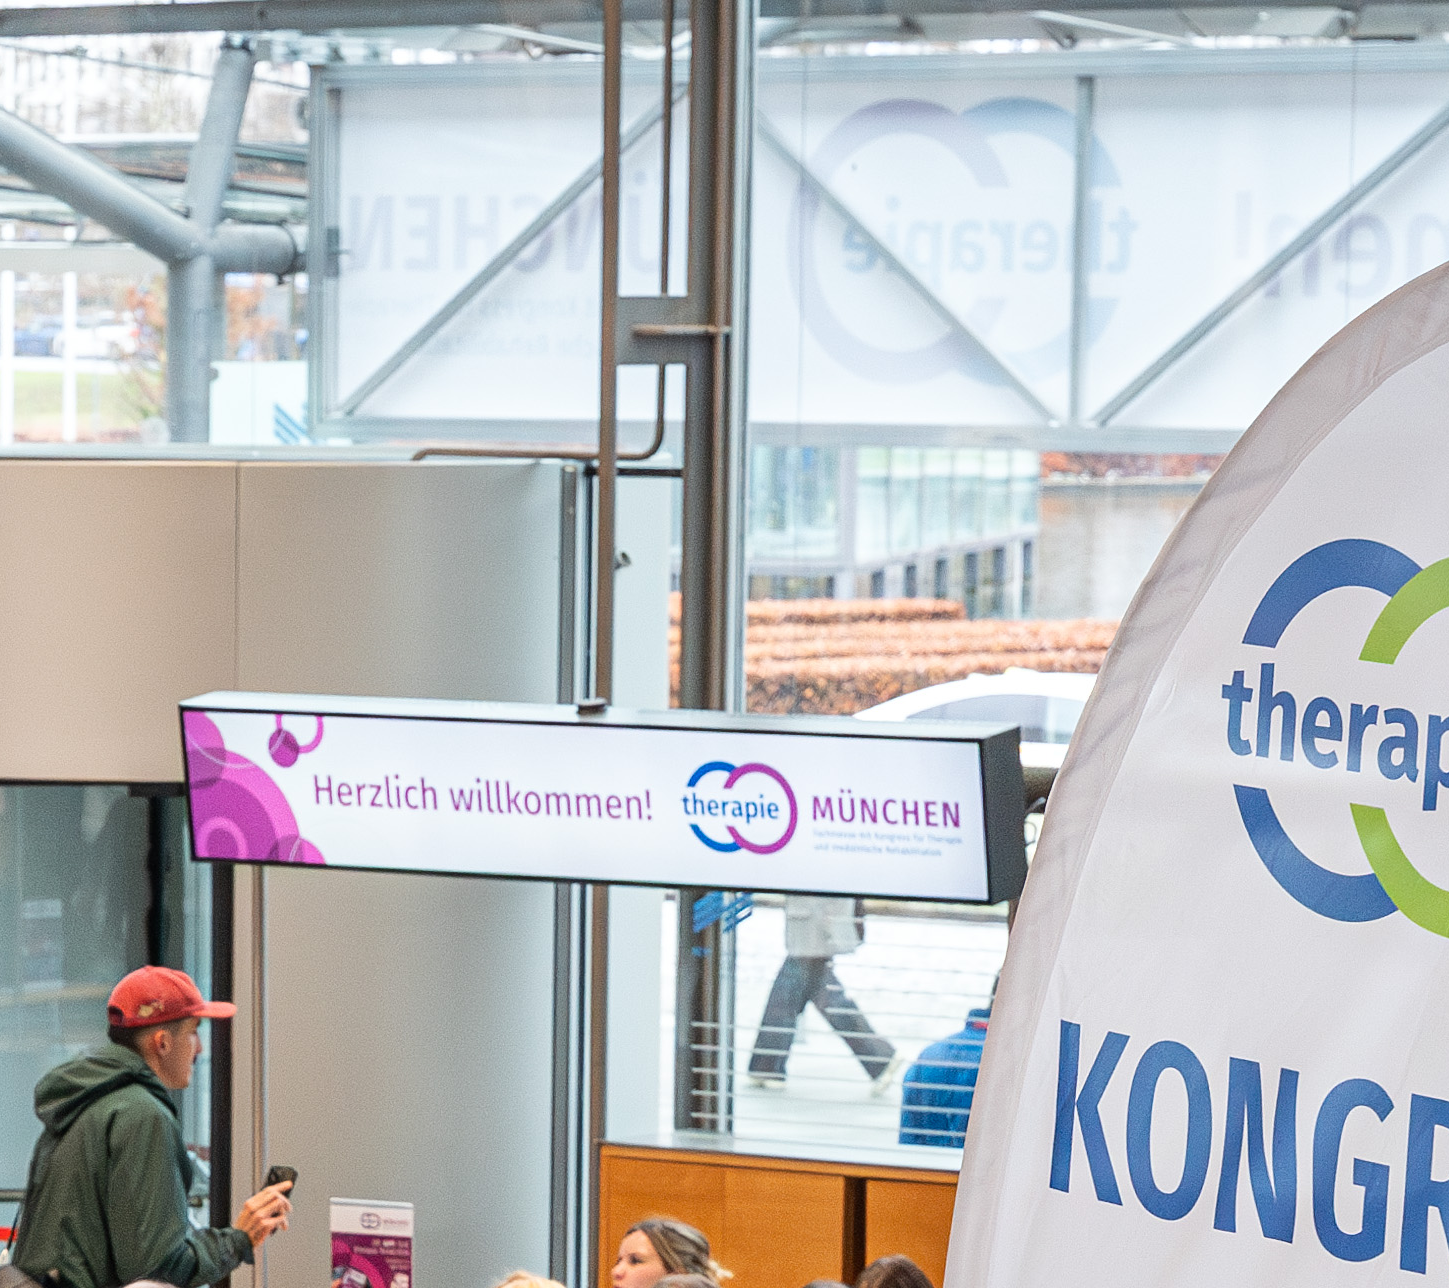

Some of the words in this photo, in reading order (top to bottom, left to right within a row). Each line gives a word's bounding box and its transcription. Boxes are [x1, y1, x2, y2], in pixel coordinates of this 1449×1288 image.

[314, 774, 438, 810] Herzlich
[450, 778, 653, 821] willkommen!
[682, 793, 780, 823] therapie
[812, 789, 962, 828] MÜNCHEN
